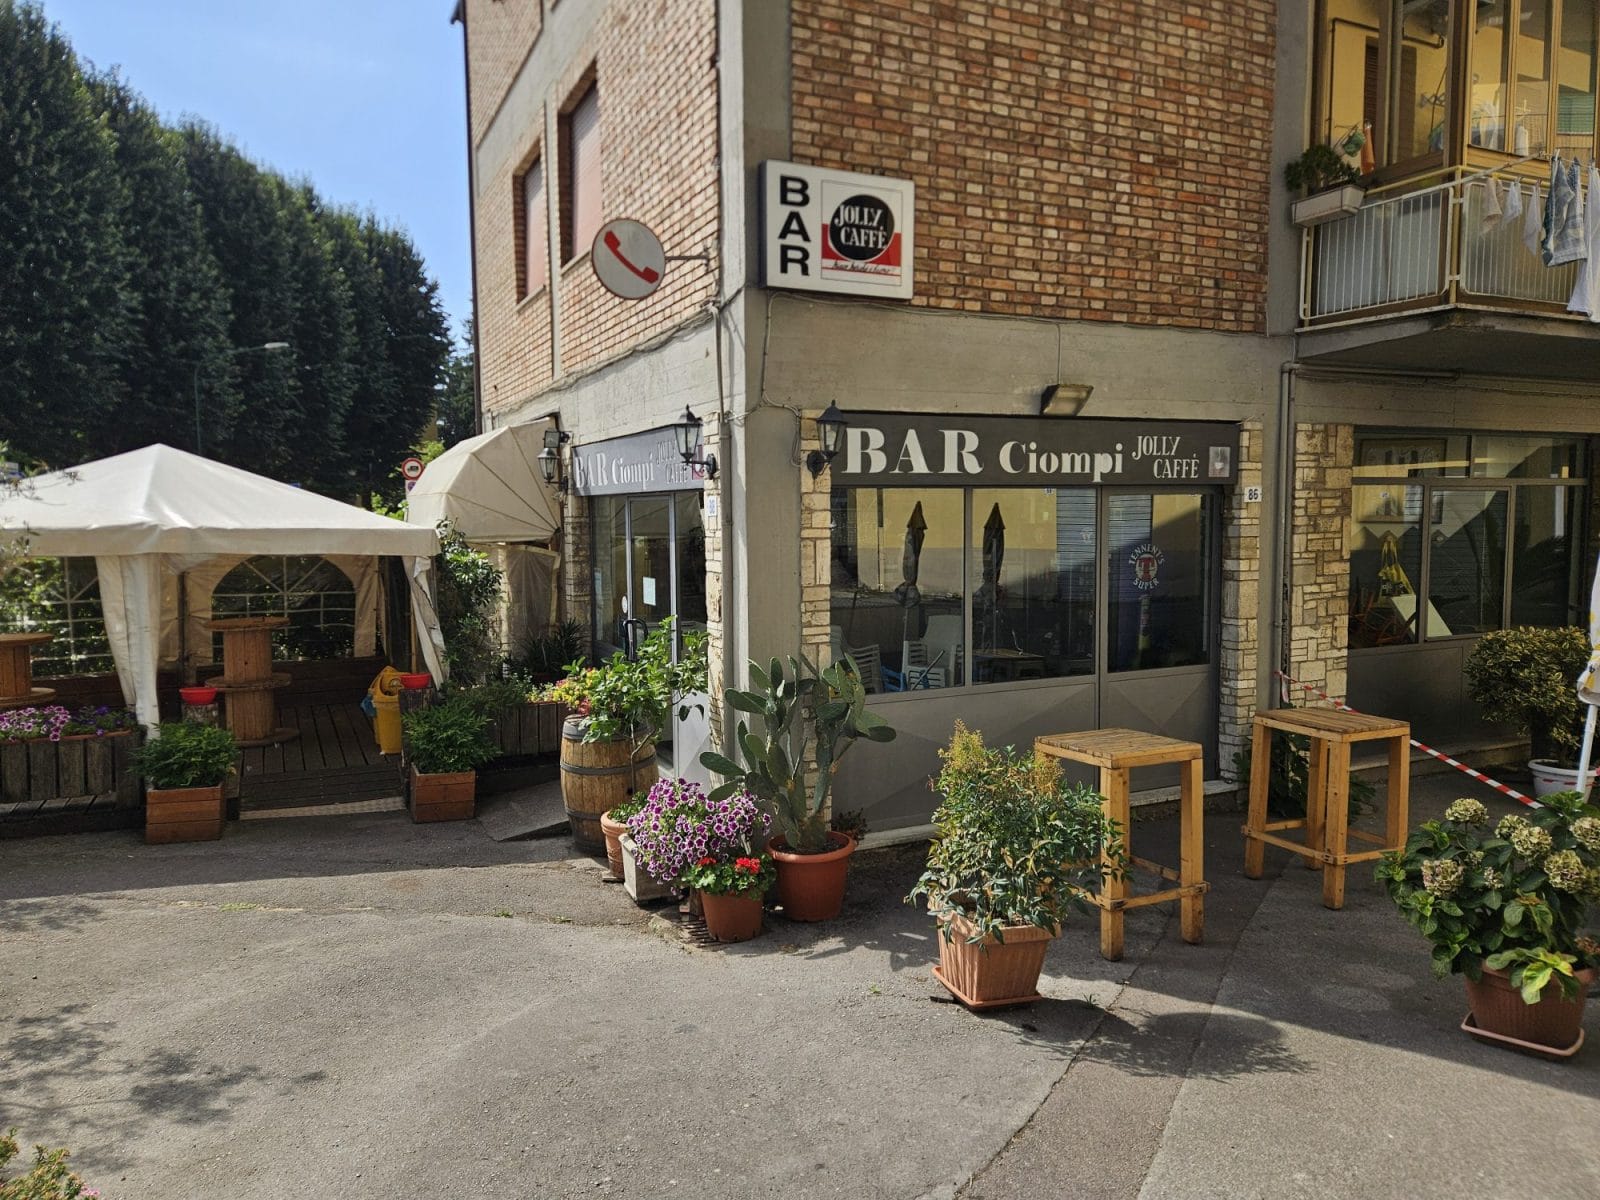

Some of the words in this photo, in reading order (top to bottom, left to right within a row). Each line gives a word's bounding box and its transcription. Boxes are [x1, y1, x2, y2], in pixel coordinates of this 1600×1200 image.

[778, 175, 811, 276] BAR
[834, 204, 883, 227] JOLLY
[841, 427, 984, 475] BAR
[999, 441, 1123, 483] Ciompi
[1132, 435, 1180, 460] JOLLY
[574, 452, 609, 488] BAR
[612, 452, 655, 490] Ciompi
[1248, 488, 1259, 500] 86
[1133, 577, 1160, 590] SUPER
